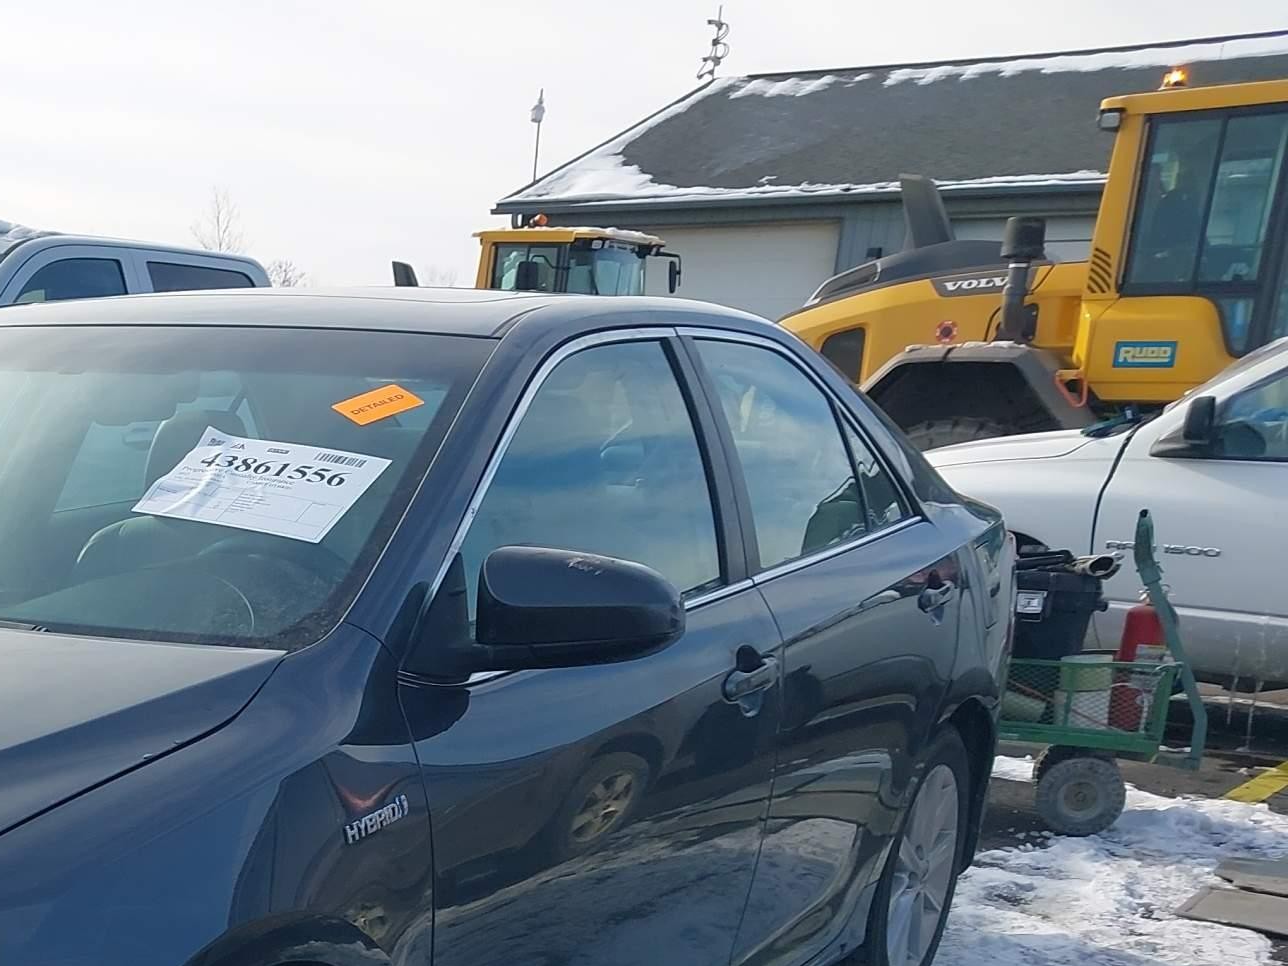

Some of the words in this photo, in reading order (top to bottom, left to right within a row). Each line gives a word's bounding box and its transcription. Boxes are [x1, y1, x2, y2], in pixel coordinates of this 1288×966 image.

[944, 277, 1010, 290] VOLV
[351, 394, 404, 415] DETAILED
[201, 452, 352, 487] 43861556
[1164, 544, 1221, 558] 1500
[345, 802, 400, 844] HYBRID
